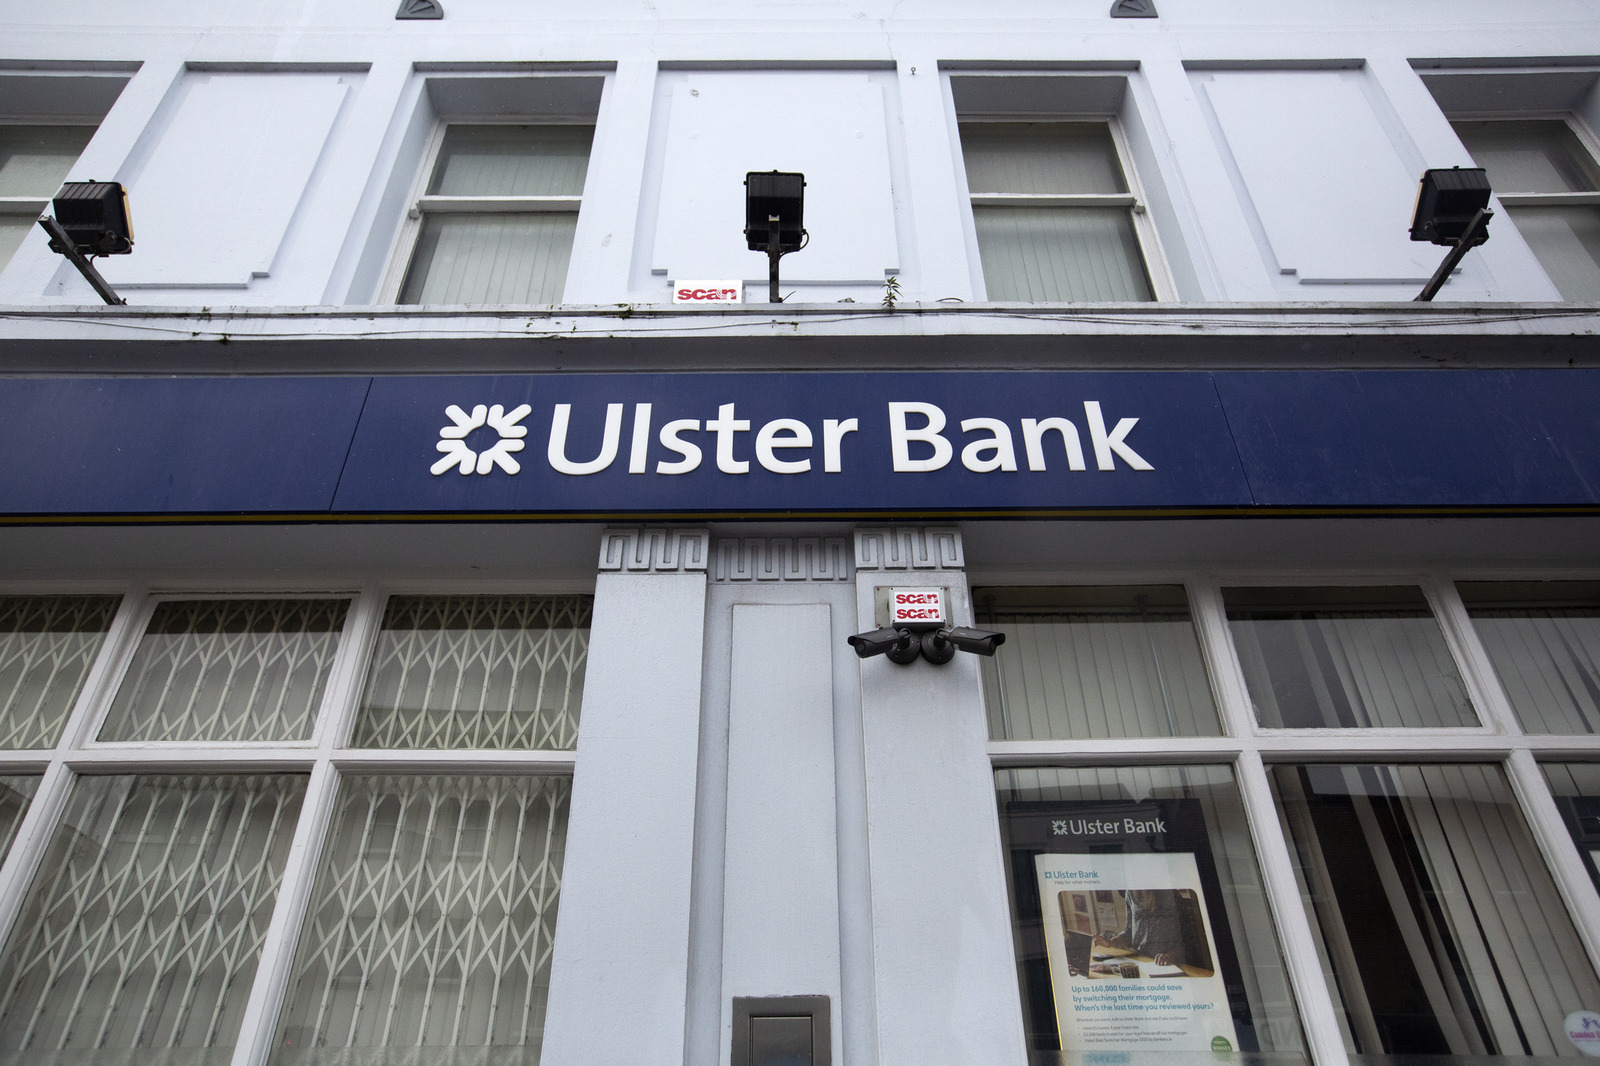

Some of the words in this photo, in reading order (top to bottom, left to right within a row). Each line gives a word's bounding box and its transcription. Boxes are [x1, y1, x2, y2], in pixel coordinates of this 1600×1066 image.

[677, 288, 737, 301] scan
[547, 402, 859, 476] Ulster
[888, 400, 1156, 473] Bank
[895, 593, 939, 604] scan
[896, 608, 940, 619] scan
[1069, 819, 1120, 835] Ulster
[1123, 817, 1167, 834] Bank
[1053, 871, 1077, 879] Ulster
[1078, 870, 1099, 879] Bank
[1071, 985, 1082, 994] Up
[1091, 984, 1118, 992] 160,000
[1118, 984, 1146, 992] families
[1146, 983, 1166, 991] could
[1072, 994, 1082, 1003] by
[1083, 994, 1117, 1003] switching
[1118, 993, 1134, 1001] their
[1136, 994, 1172, 1002] mortgage.
[1113, 1003, 1126, 1011] last
[1159, 1002, 1191, 1010] reviewed
[1191, 1002, 1214, 1011] yours?
